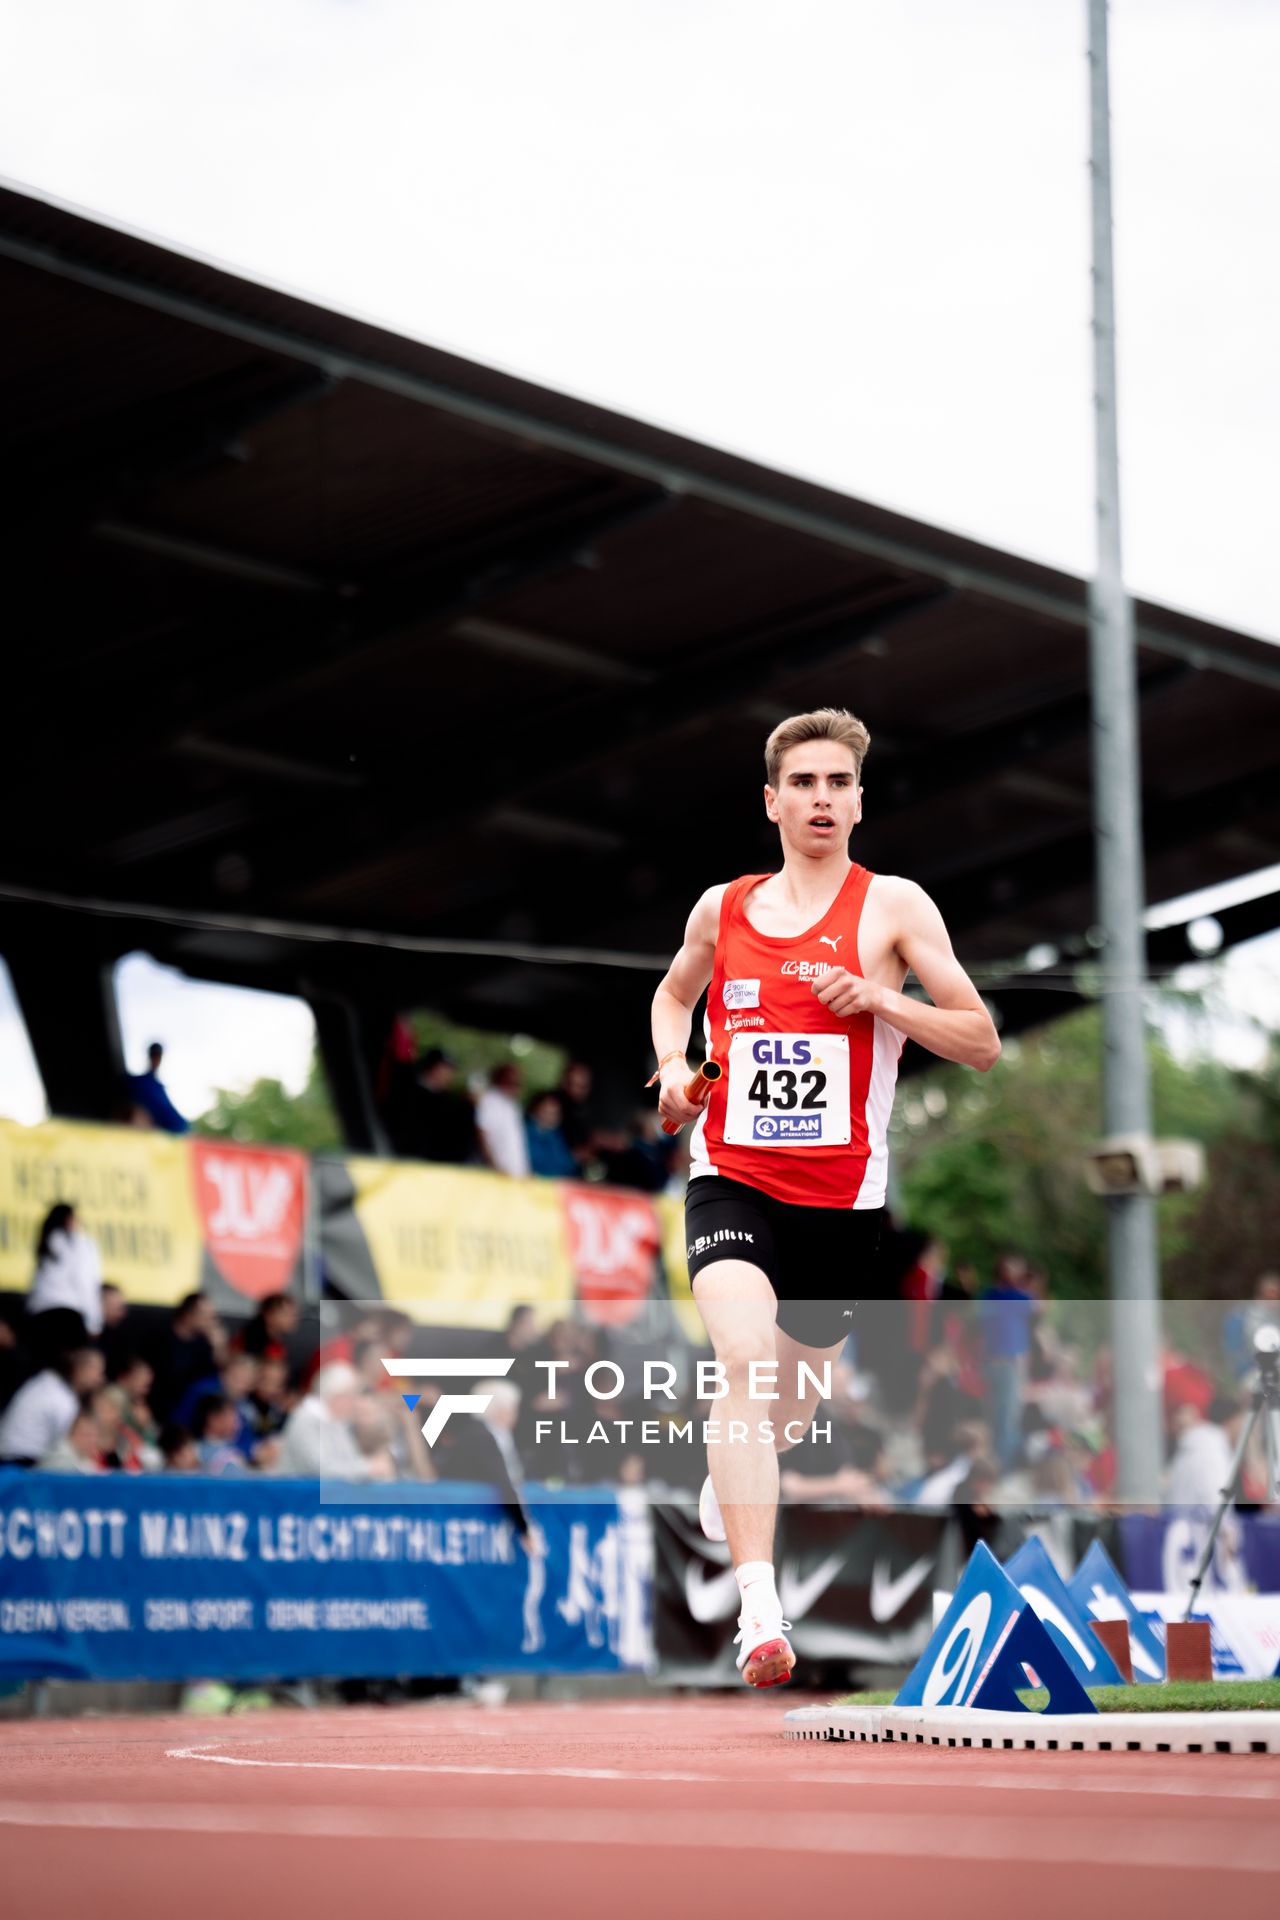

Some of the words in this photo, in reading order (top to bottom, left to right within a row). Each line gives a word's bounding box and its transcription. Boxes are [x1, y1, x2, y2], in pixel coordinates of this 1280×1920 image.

[748, 1069, 827, 1110] 432
[780, 1118, 819, 1131] PLAN
[0, 1508, 127, 1561] CHOTT
[139, 1510, 249, 1562] MAINZ
